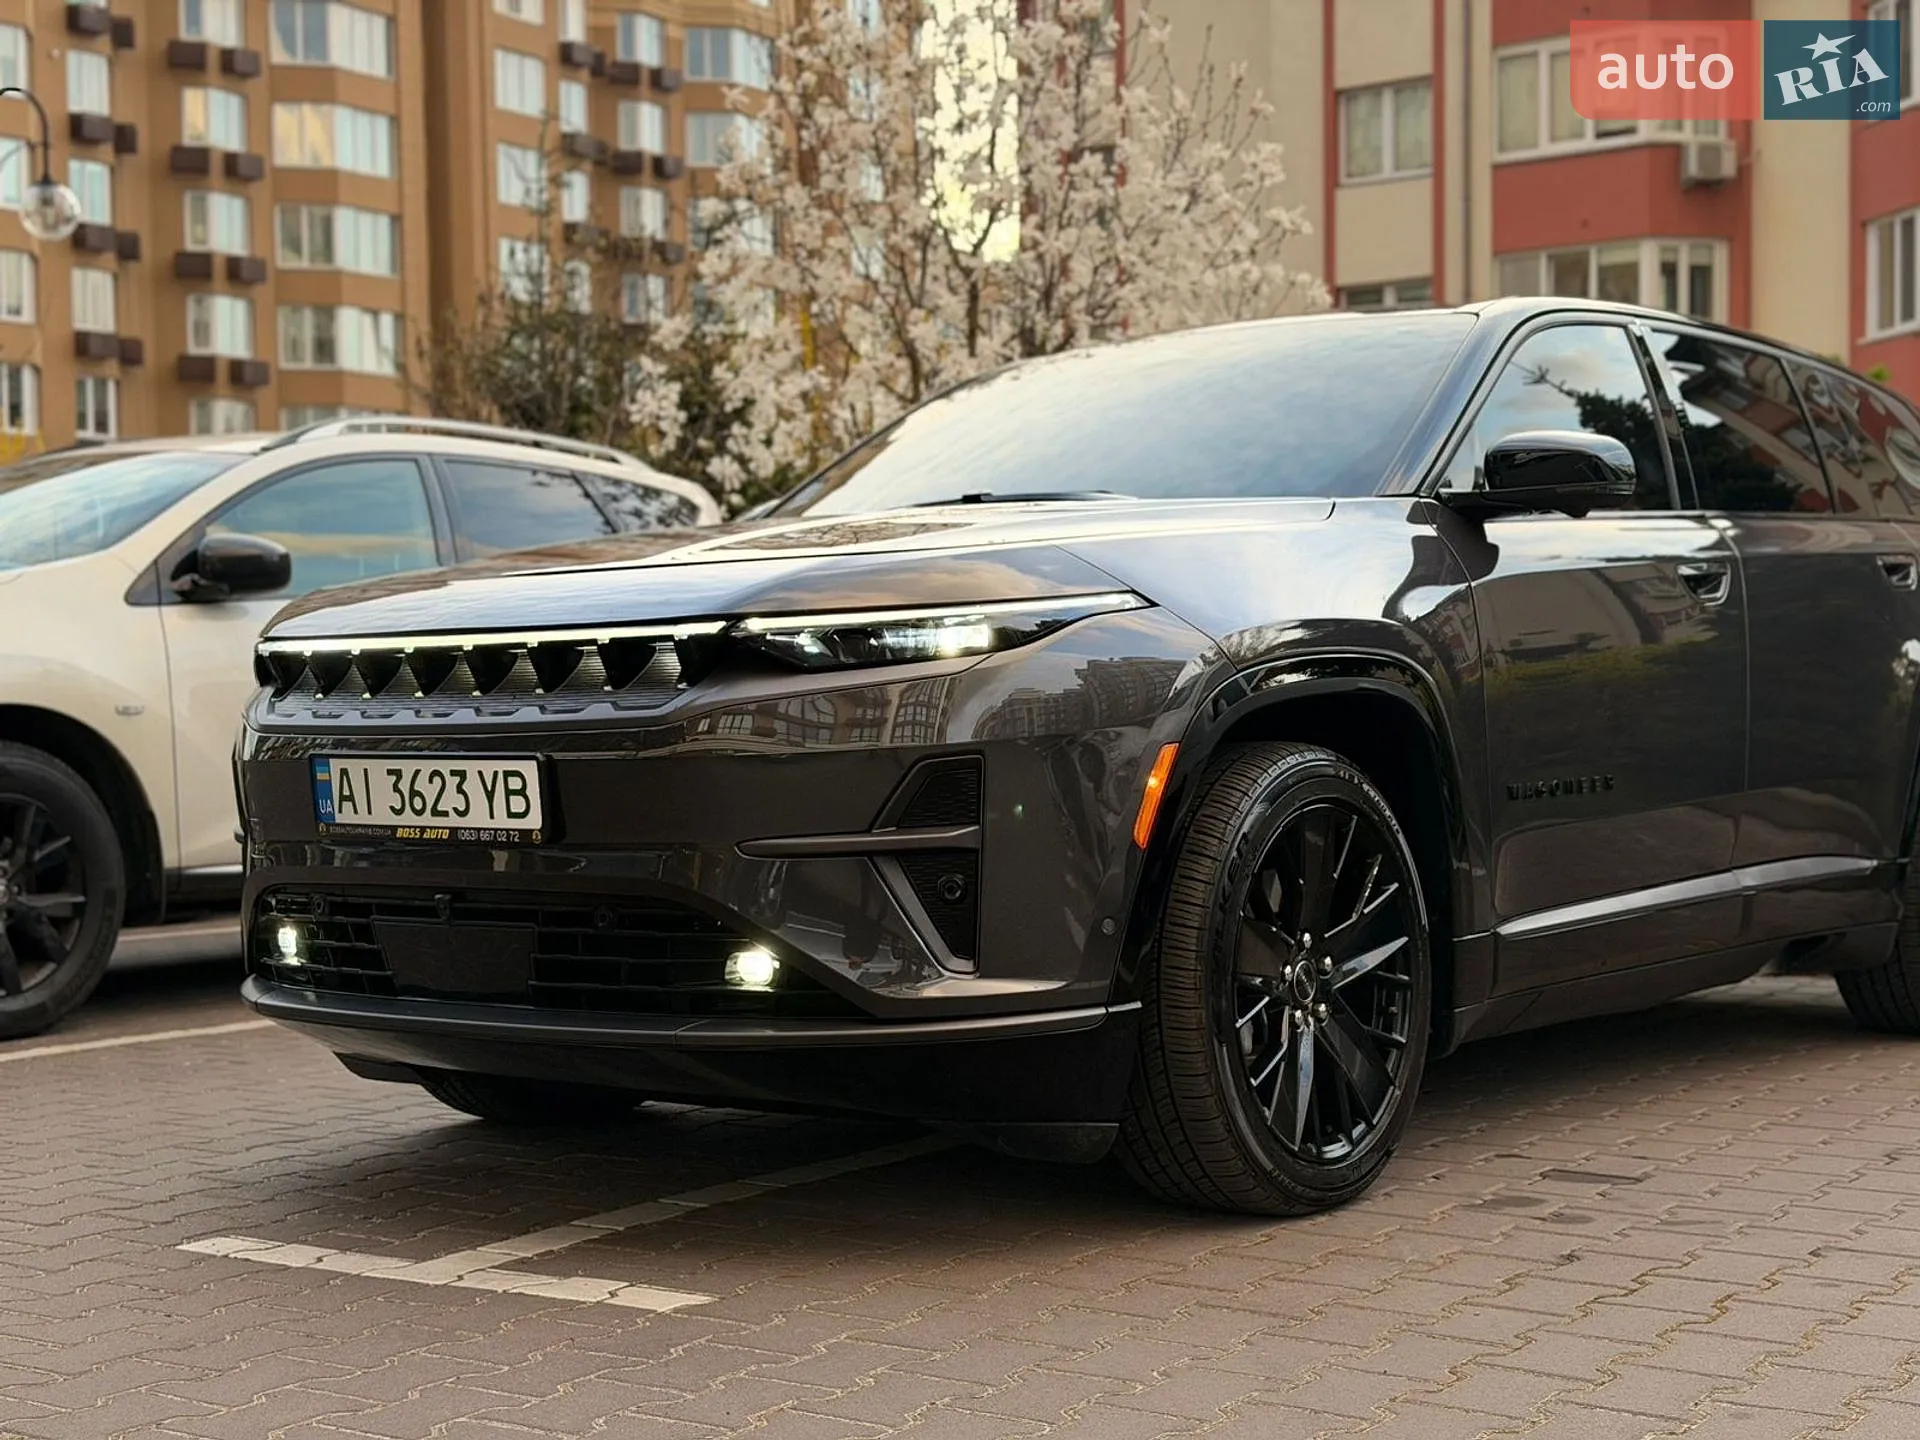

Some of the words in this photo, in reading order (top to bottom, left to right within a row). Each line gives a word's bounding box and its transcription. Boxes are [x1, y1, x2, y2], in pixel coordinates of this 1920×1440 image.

[337, 767, 373, 815] AI
[386, 768, 471, 818] 3623
[477, 769, 532, 819] YB
[319, 799, 334, 815] UA
[395, 827, 421, 839] BOSS
[423, 828, 450, 840] AUTO
[496, 831, 508, 842] 02
[509, 831, 520, 843] 72
